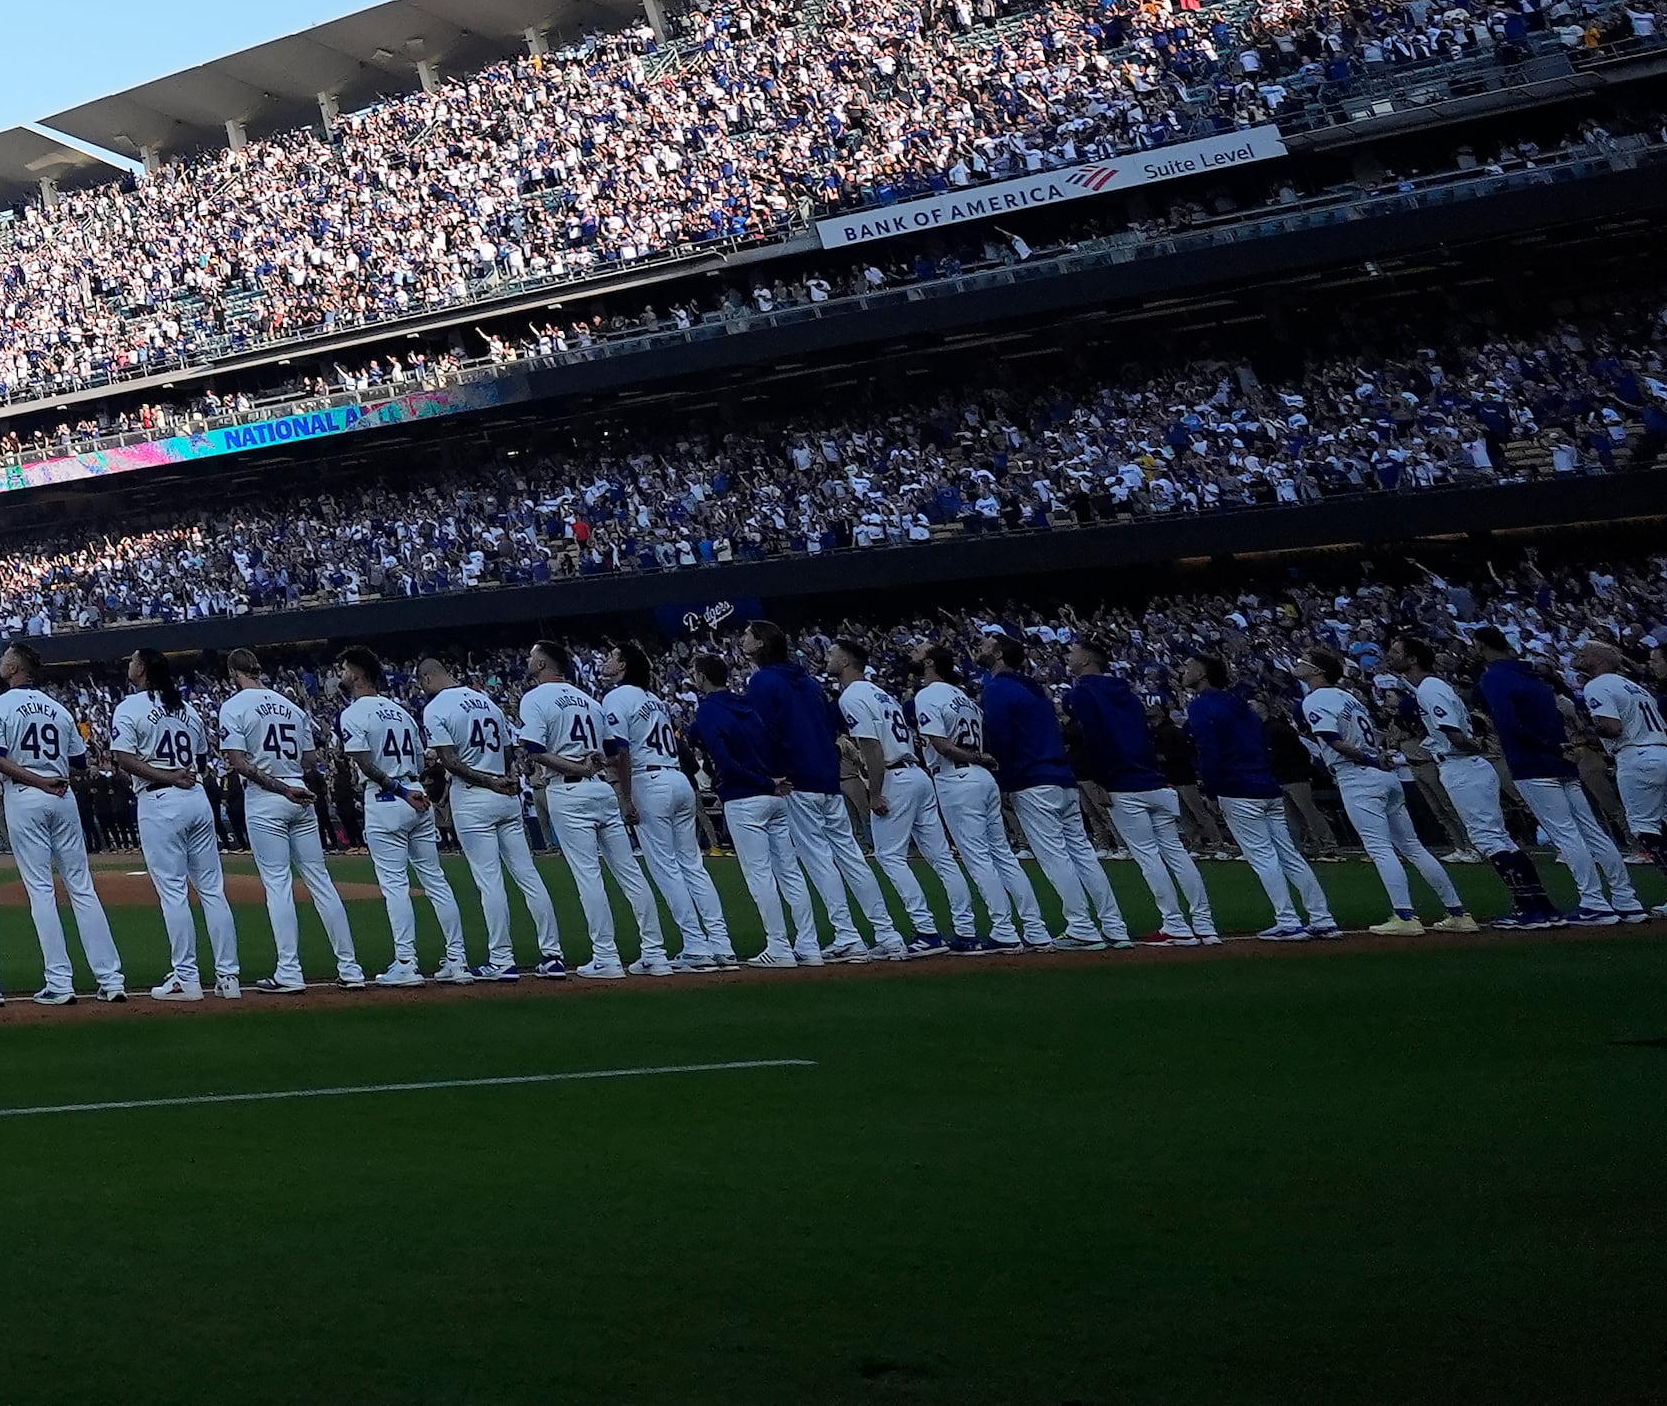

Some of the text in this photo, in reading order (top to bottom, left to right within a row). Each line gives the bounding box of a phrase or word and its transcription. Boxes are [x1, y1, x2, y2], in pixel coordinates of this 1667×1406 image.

[1143, 144, 1255, 180] Suite Level
[843, 184, 1065, 242] BANK OF AMERICA
[223, 414, 340, 449] NATIONAL
[255, 703, 293, 721] KOPECH
[1637, 701, 1663, 732] 11
[20, 722, 61, 761] 49
[155, 729, 193, 767] 48
[263, 723, 298, 760] 45
[383, 728, 415, 765] 44
[470, 717, 501, 754] 43
[570, 714, 598, 750] 41
[645, 721, 678, 759] 40
[1357, 715, 1376, 748] 8
